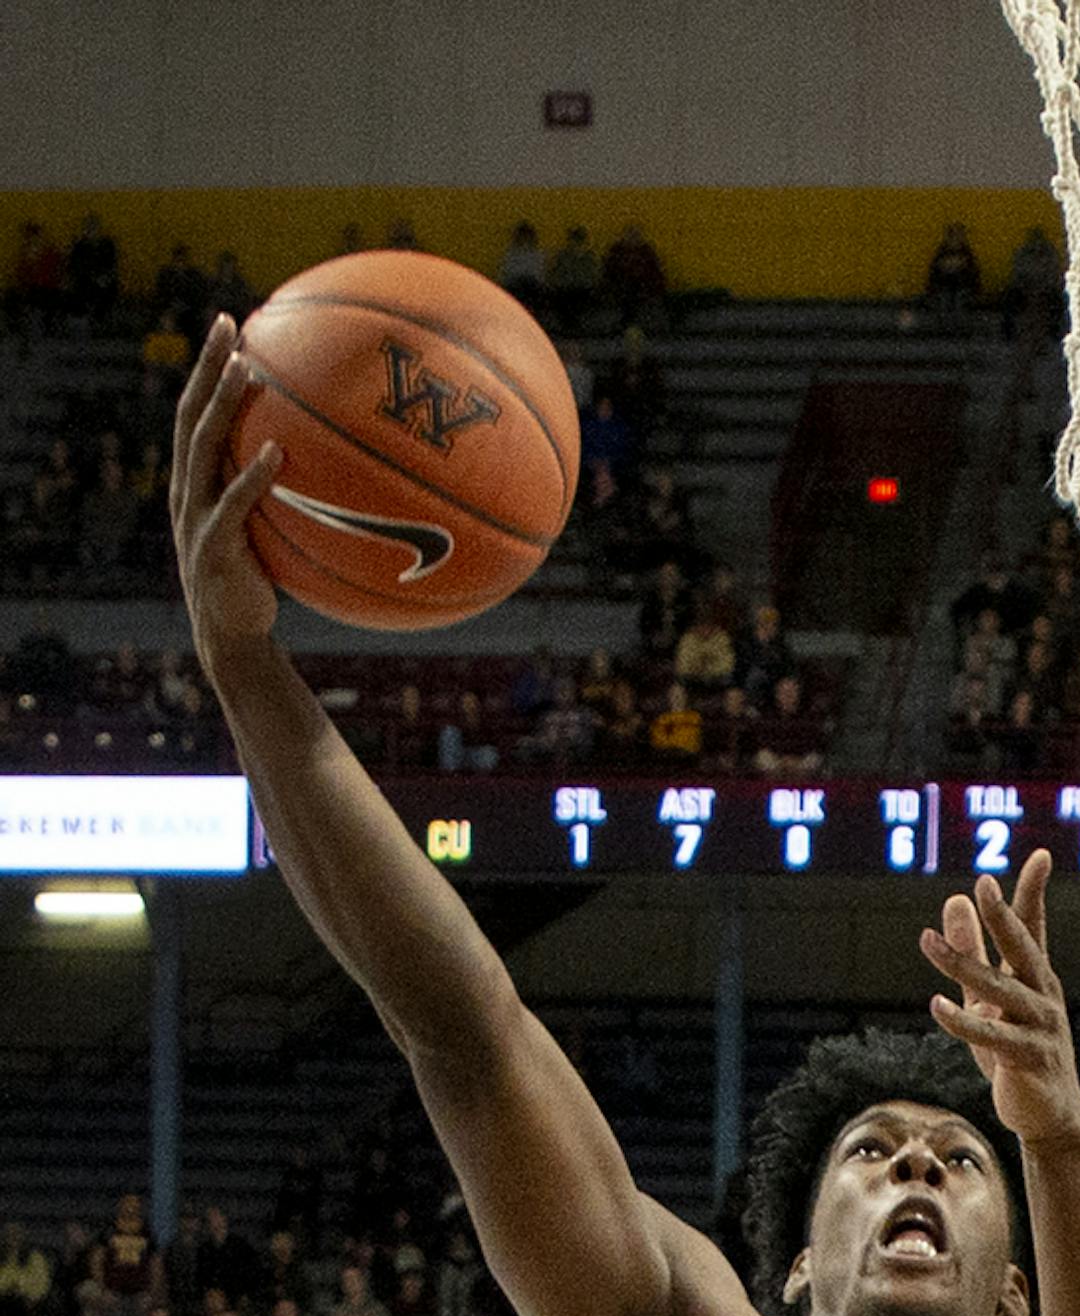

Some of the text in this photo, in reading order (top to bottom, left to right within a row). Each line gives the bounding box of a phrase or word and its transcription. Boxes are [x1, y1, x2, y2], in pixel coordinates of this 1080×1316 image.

[555, 787, 606, 820] STL
[659, 788, 715, 821] AST
[768, 789, 825, 822] BLK
[881, 790, 920, 822] TO
[428, 819, 471, 860] CU
[570, 823, 589, 864] 1
[674, 824, 701, 865] 7
[785, 824, 811, 866] 0
[890, 825, 915, 867] 6
[974, 819, 1010, 869] 2
